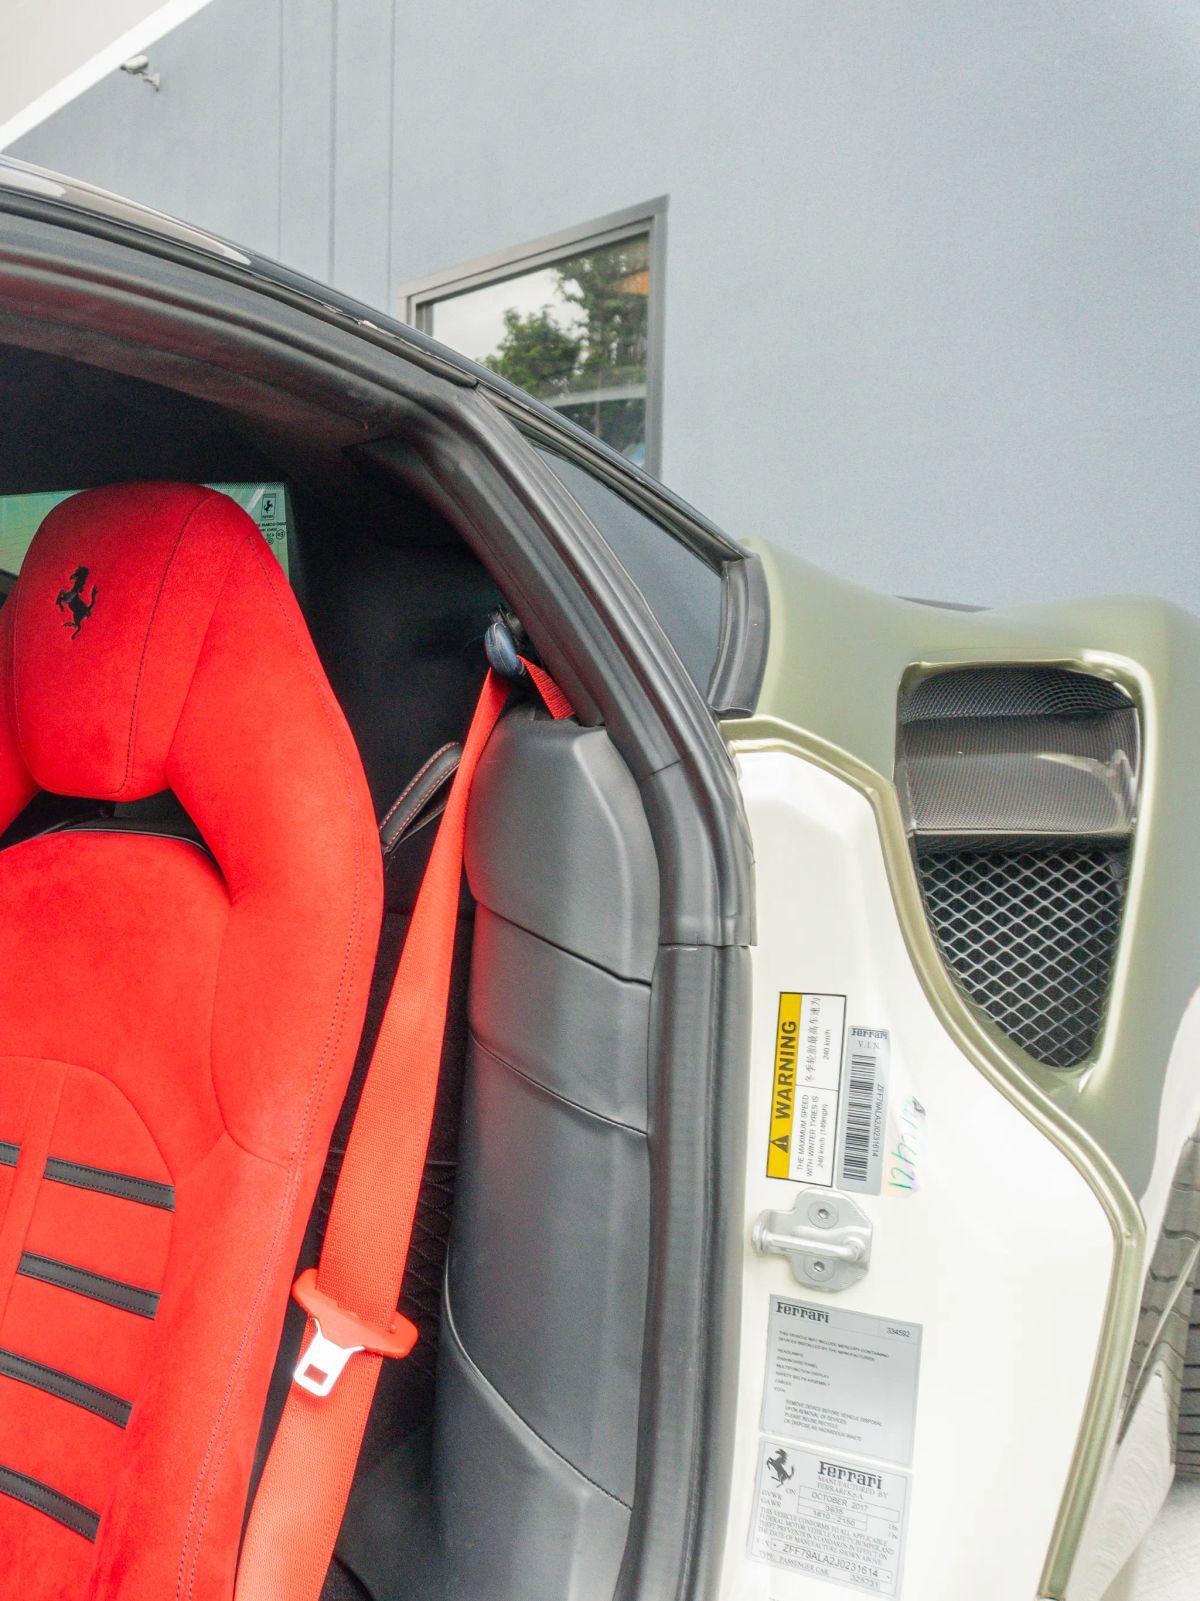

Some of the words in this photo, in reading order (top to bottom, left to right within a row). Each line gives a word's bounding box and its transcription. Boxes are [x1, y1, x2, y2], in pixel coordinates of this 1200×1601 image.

[823, 1029, 831, 1046] km/h
[851, 1028, 888, 1040] Ferrari
[822, 1048, 830, 1060] 240
[775, 1021, 797, 1120] WARNING
[810, 1105, 818, 1126] TYRES
[798, 1120, 806, 1154] MAXIMUM
[808, 1129, 816, 1156] WINTER
[818, 1137, 826, 1154] km/h
[806, 1159, 814, 1176] WITH
[776, 1301, 829, 1323] Ferrari
[817, 1461, 883, 1490] Ferrari
[818, 1476, 875, 1495] MANUFACTURED
[817, 1483, 846, 1495] FERRARI
[785, 1487, 795, 1495] ON
[811, 1492, 847, 1507] OCTOBER
[851, 1502, 868, 1512] 2017
